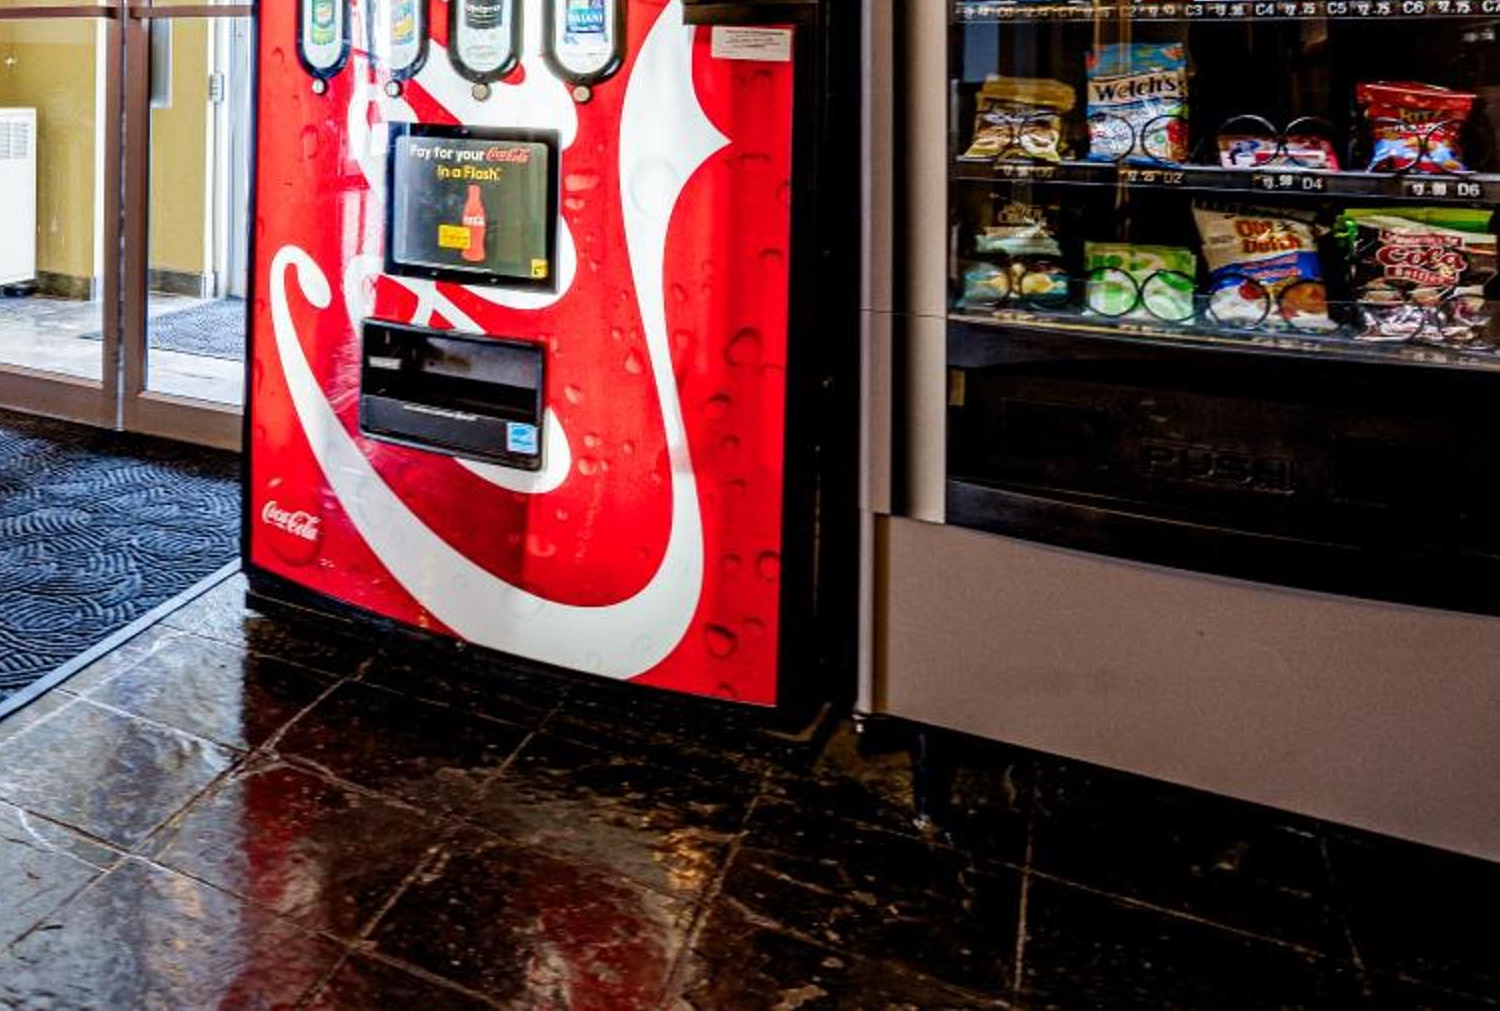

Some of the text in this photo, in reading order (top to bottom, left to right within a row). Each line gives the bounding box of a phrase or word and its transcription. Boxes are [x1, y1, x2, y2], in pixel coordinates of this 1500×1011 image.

[1185, 4, 1204, 16] C3
[1255, 3, 1275, 15] C4
[1326, 1, 1347, 15] C5
[1403, 0, 1425, 14] C6
[410, 146, 431, 160] Pay
[435, 146, 454, 159] for
[456, 149, 485, 162] your
[451, 169, 460, 178] a
[1303, 177, 1323, 189] D4
[1457, 182, 1481, 197] D6
[1376, 245, 1467, 271] Cola
[261, 500, 322, 541] Coca-Cola
